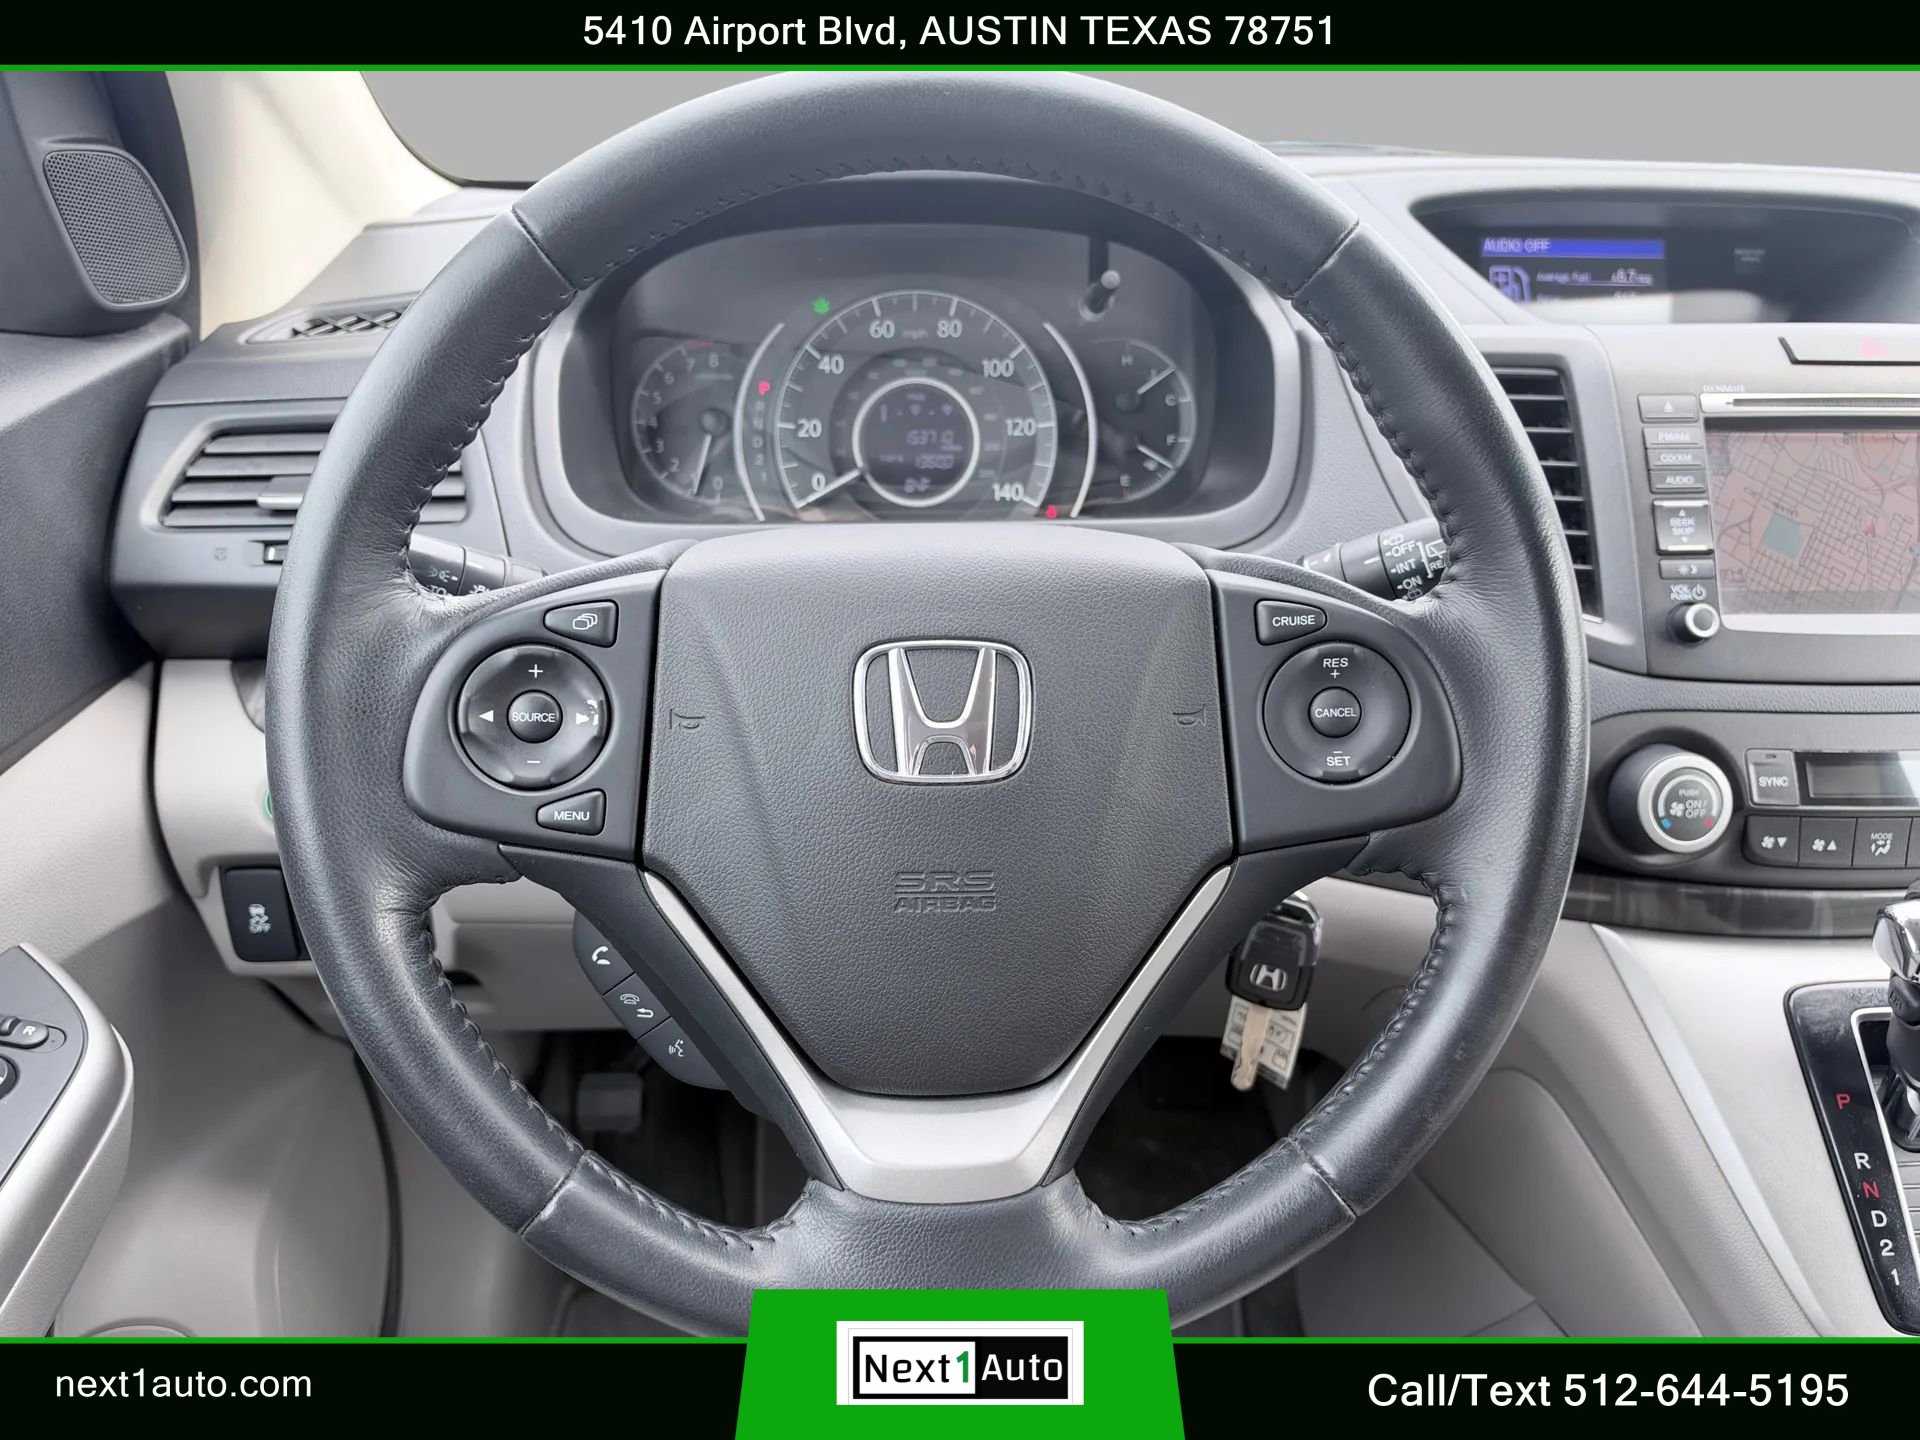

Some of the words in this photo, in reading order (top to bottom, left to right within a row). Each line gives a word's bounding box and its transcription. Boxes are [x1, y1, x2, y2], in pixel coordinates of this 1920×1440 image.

[1483, 238, 1520, 252] AUDIO
[869, 320, 895, 338] 60
[936, 319, 963, 338] 80
[817, 357, 845, 375] 40
[981, 359, 1015, 378] 100
[797, 418, 822, 438] 20
[1005, 418, 1037, 437] 120
[811, 473, 827, 491] 0
[1665, 475, 1695, 485] AUDIO
[992, 483, 1025, 502] 140
[1391, 539, 1416, 558] OFF
[1395, 558, 1416, 575] INT
[1402, 575, 1423, 590] ON
[1272, 614, 1316, 627] CRUISE
[1322, 657, 1349, 669] RES
[510, 711, 556, 723] SOURCE
[1314, 707, 1358, 719] CANCEL
[1326, 755, 1351, 767] SET
[1758, 776, 1790, 788] SYNC
[553, 810, 590, 822] MENU
[1870, 832, 1893, 841] MODE
[894, 871, 996, 892] SRS
[893, 895, 997, 913] AIRBAG
[22, 1025, 36, 1036] R
[1835, 1093, 1850, 1110] P
[1853, 1152, 1872, 1170] R
[1862, 1181, 1880, 1199] N
[1870, 1210, 1888, 1228] D
[1879, 1239, 1896, 1257] 2
[1891, 1268, 1900, 1286] 1
